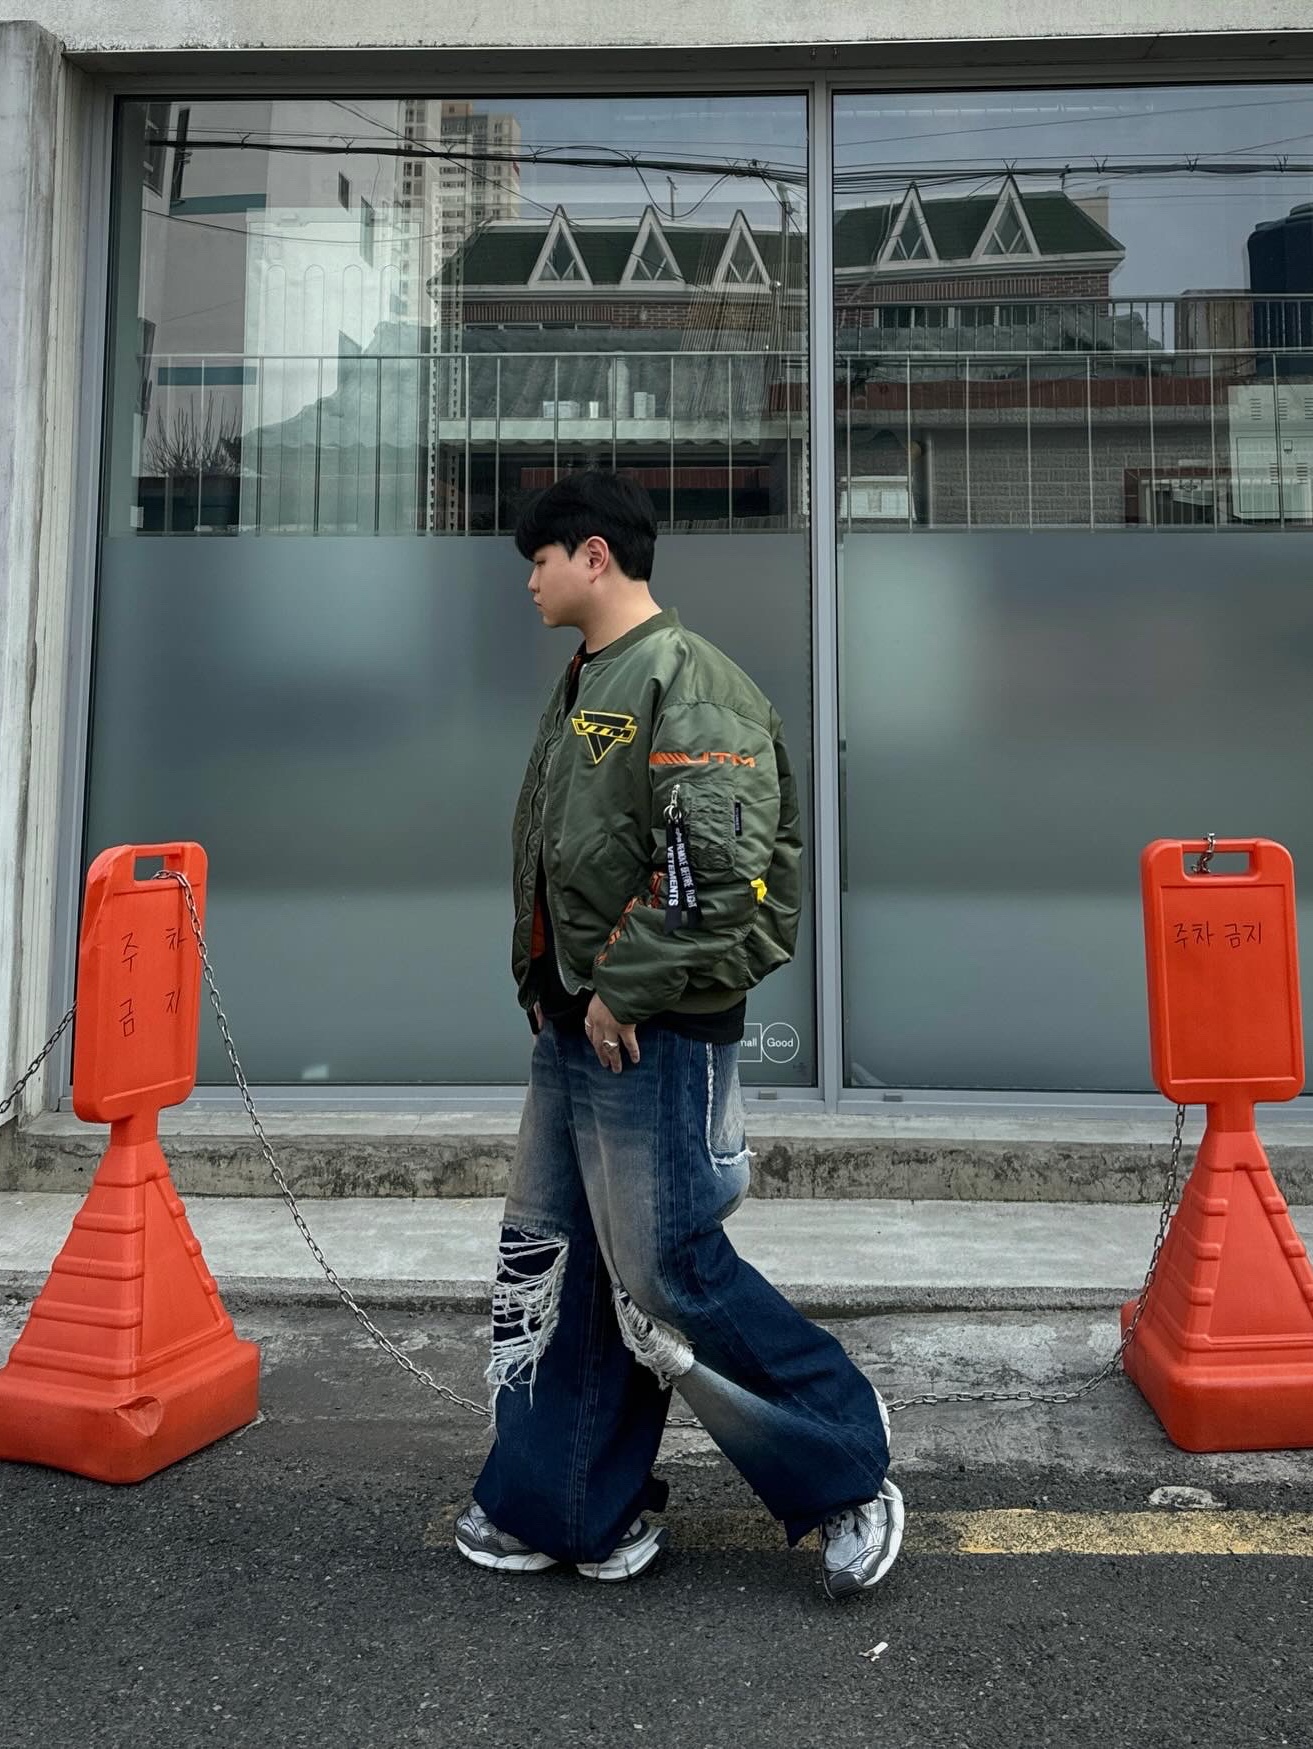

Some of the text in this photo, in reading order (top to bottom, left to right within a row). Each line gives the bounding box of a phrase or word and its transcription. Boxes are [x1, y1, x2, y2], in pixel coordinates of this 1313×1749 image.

[576, 722, 634, 738] VTM
[667, 846, 679, 906] VETEMENTS
[1173, 921, 1262, 949] 주차 금지
[766, 1037, 794, 1048] Good
